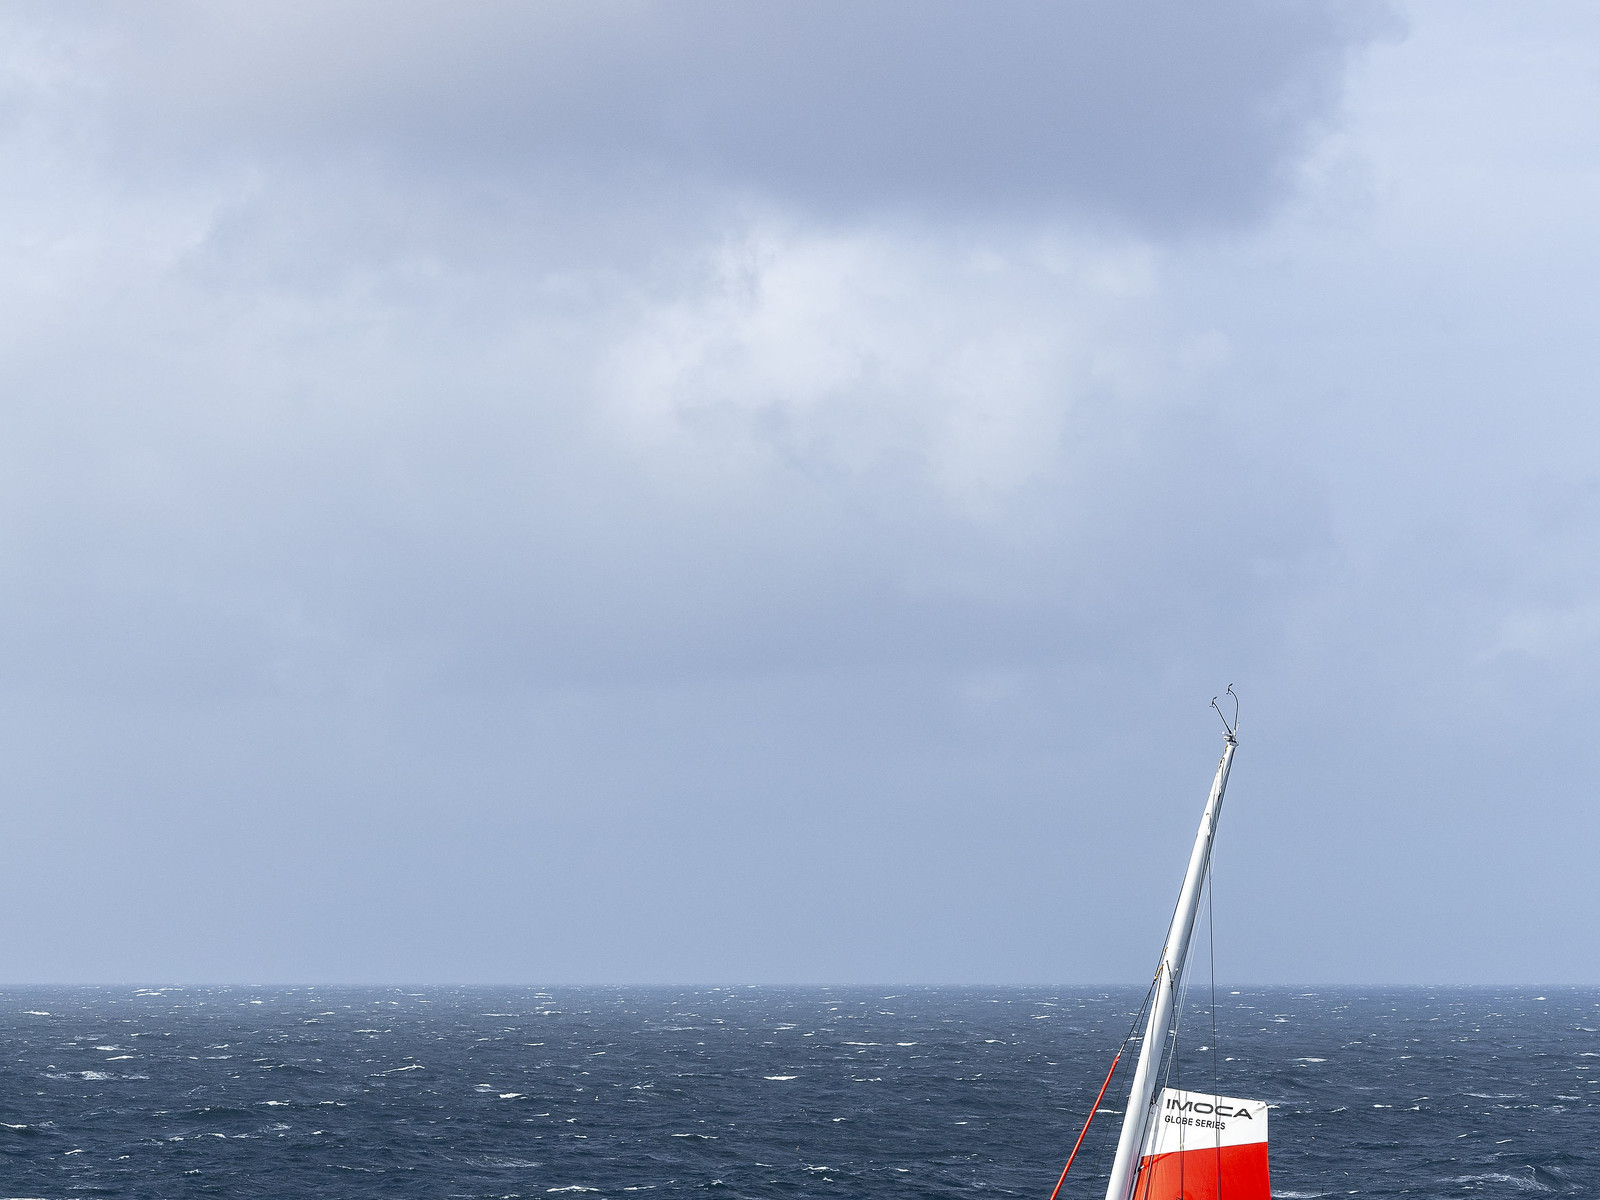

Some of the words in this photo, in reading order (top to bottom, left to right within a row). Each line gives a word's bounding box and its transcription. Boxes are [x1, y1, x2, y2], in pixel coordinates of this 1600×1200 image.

[1166, 1098, 1253, 1120] IMOCA
[1164, 1115, 1193, 1126] GLOBE
[1195, 1119, 1226, 1130] SERIES
